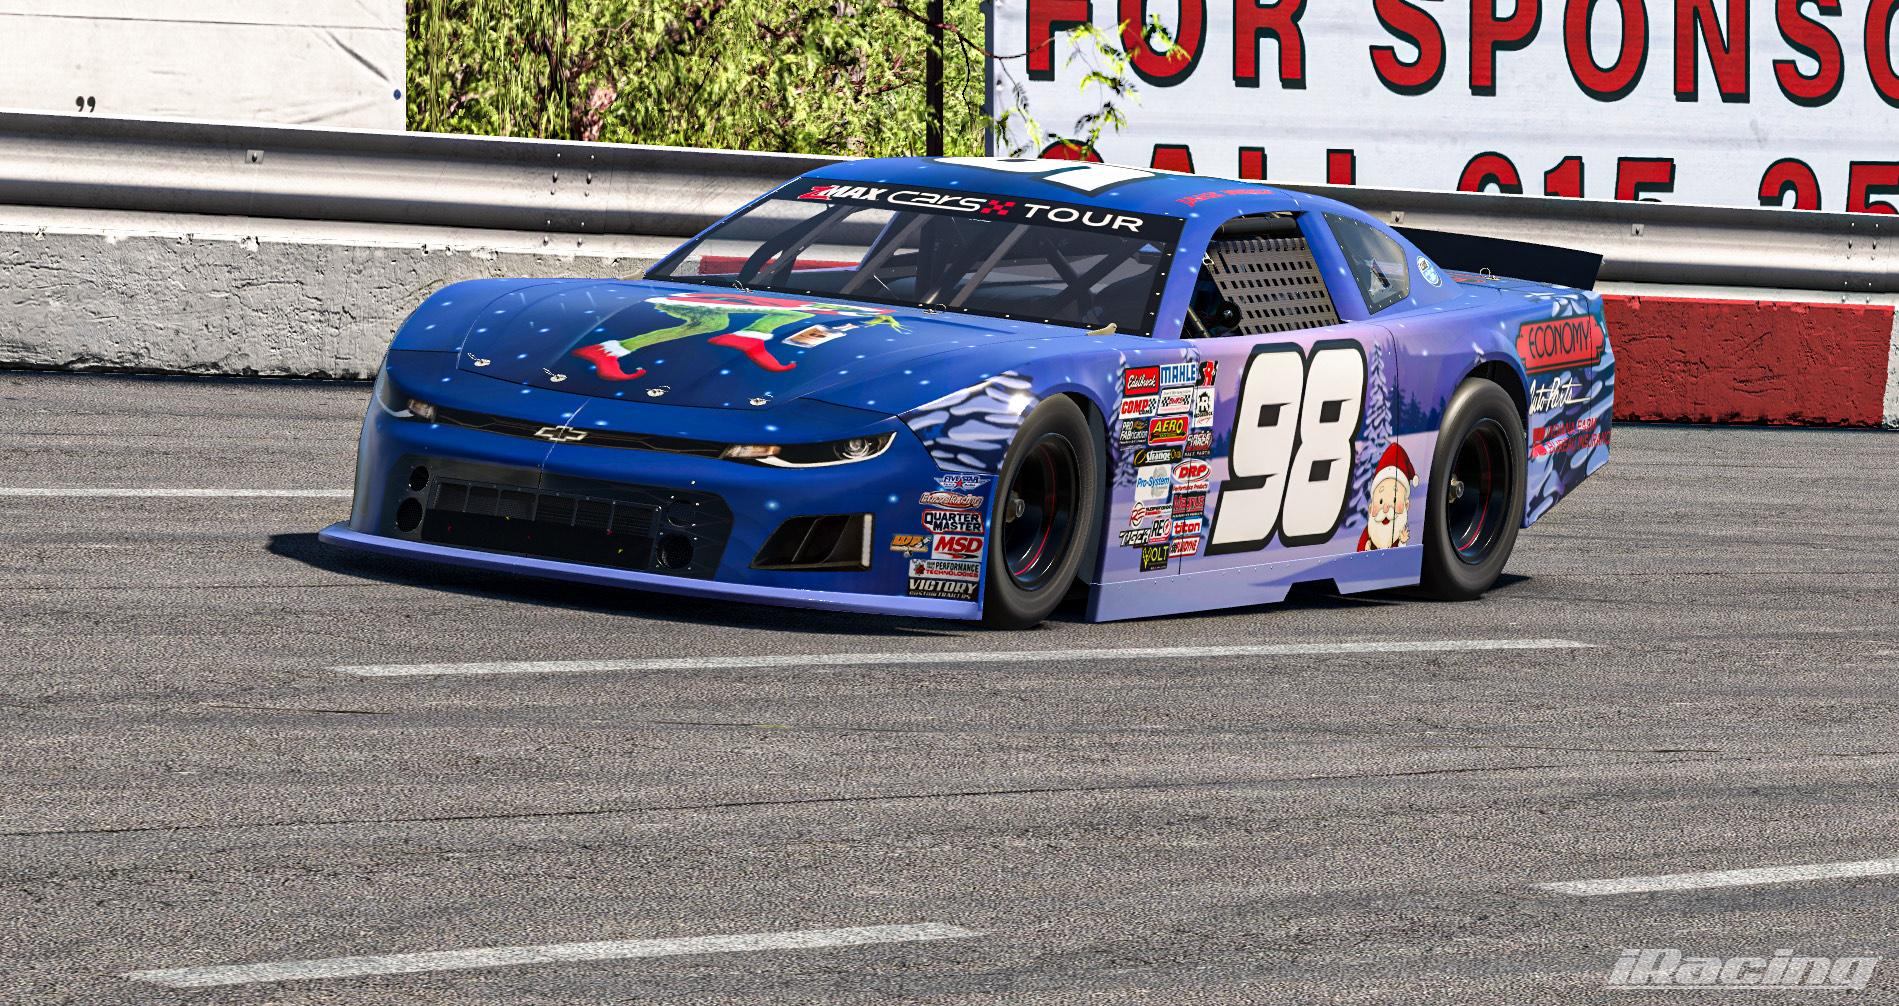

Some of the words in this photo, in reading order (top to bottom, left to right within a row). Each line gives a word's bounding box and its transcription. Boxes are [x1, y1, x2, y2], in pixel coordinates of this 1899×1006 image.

[1026, 0, 1307, 90] FOR
[1369, 0, 1899, 109] SPONS
[1024, 202, 1144, 233] TOUR
[1528, 320, 1590, 359] ECONOMY
[1127, 374, 1156, 389] Edelbrock
[1161, 364, 1196, 384] MAHLE
[1121, 398, 1149, 415] COMP
[1122, 421, 1133, 431] PRO
[1153, 419, 1184, 433] AERO
[1205, 339, 1367, 556] 98
[1179, 464, 1207, 479] DRP
[1136, 476, 1170, 488] Pro-System
[925, 512, 980, 525] QUARTER
[933, 522, 981, 532] MASTER
[934, 536, 983, 553] MSD
[926, 569, 979, 577] TECHNOLOGIES
[935, 561, 979, 573] PERFORMANCE
[909, 579, 977, 594] VICTORY
